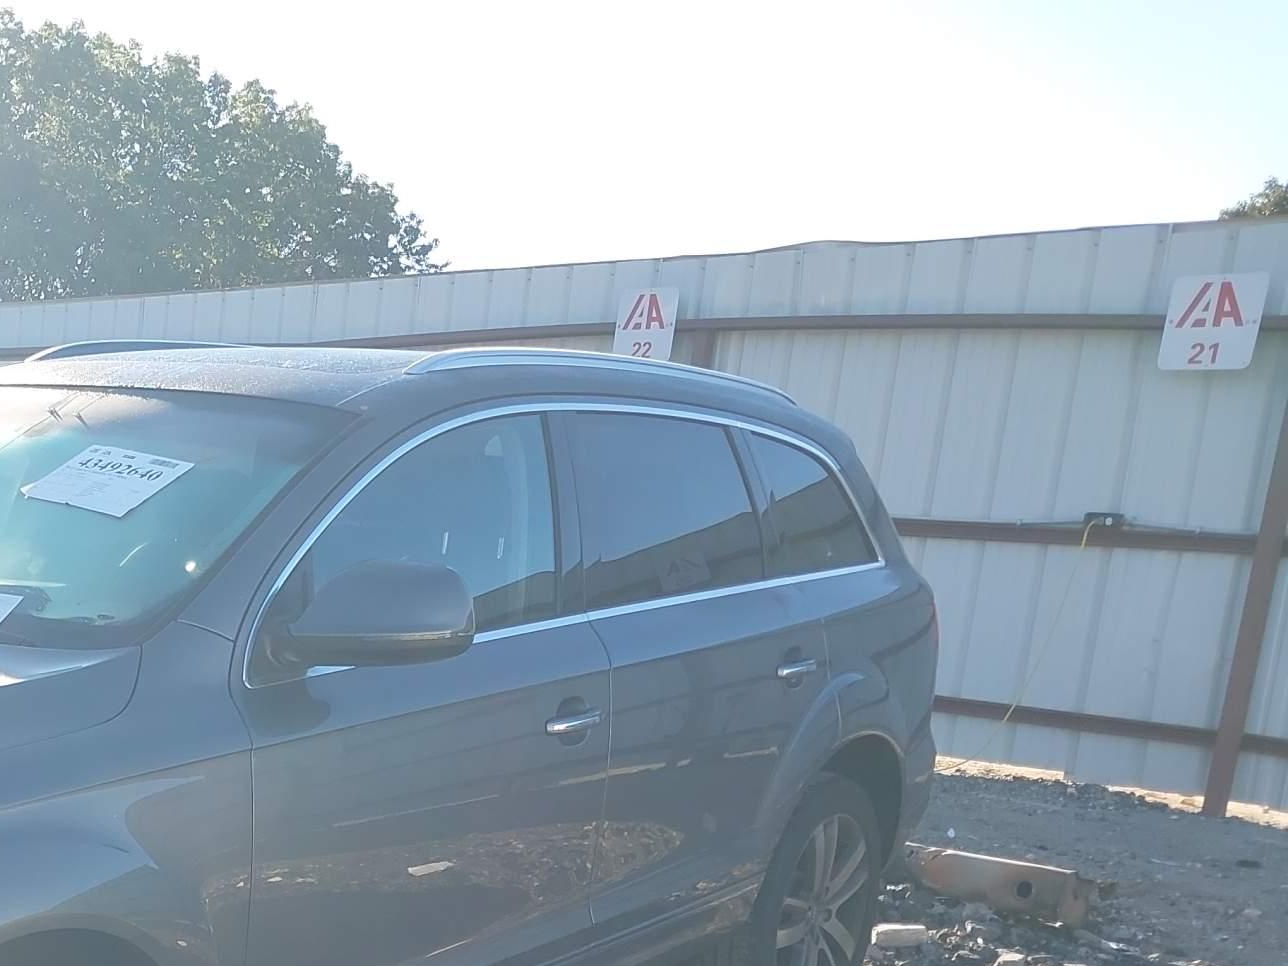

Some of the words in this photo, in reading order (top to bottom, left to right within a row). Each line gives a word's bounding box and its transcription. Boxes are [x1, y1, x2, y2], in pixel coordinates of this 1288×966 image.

[631, 342, 652, 358] 22
[1187, 342, 1220, 364] 21
[78, 456, 164, 482] 43492640
